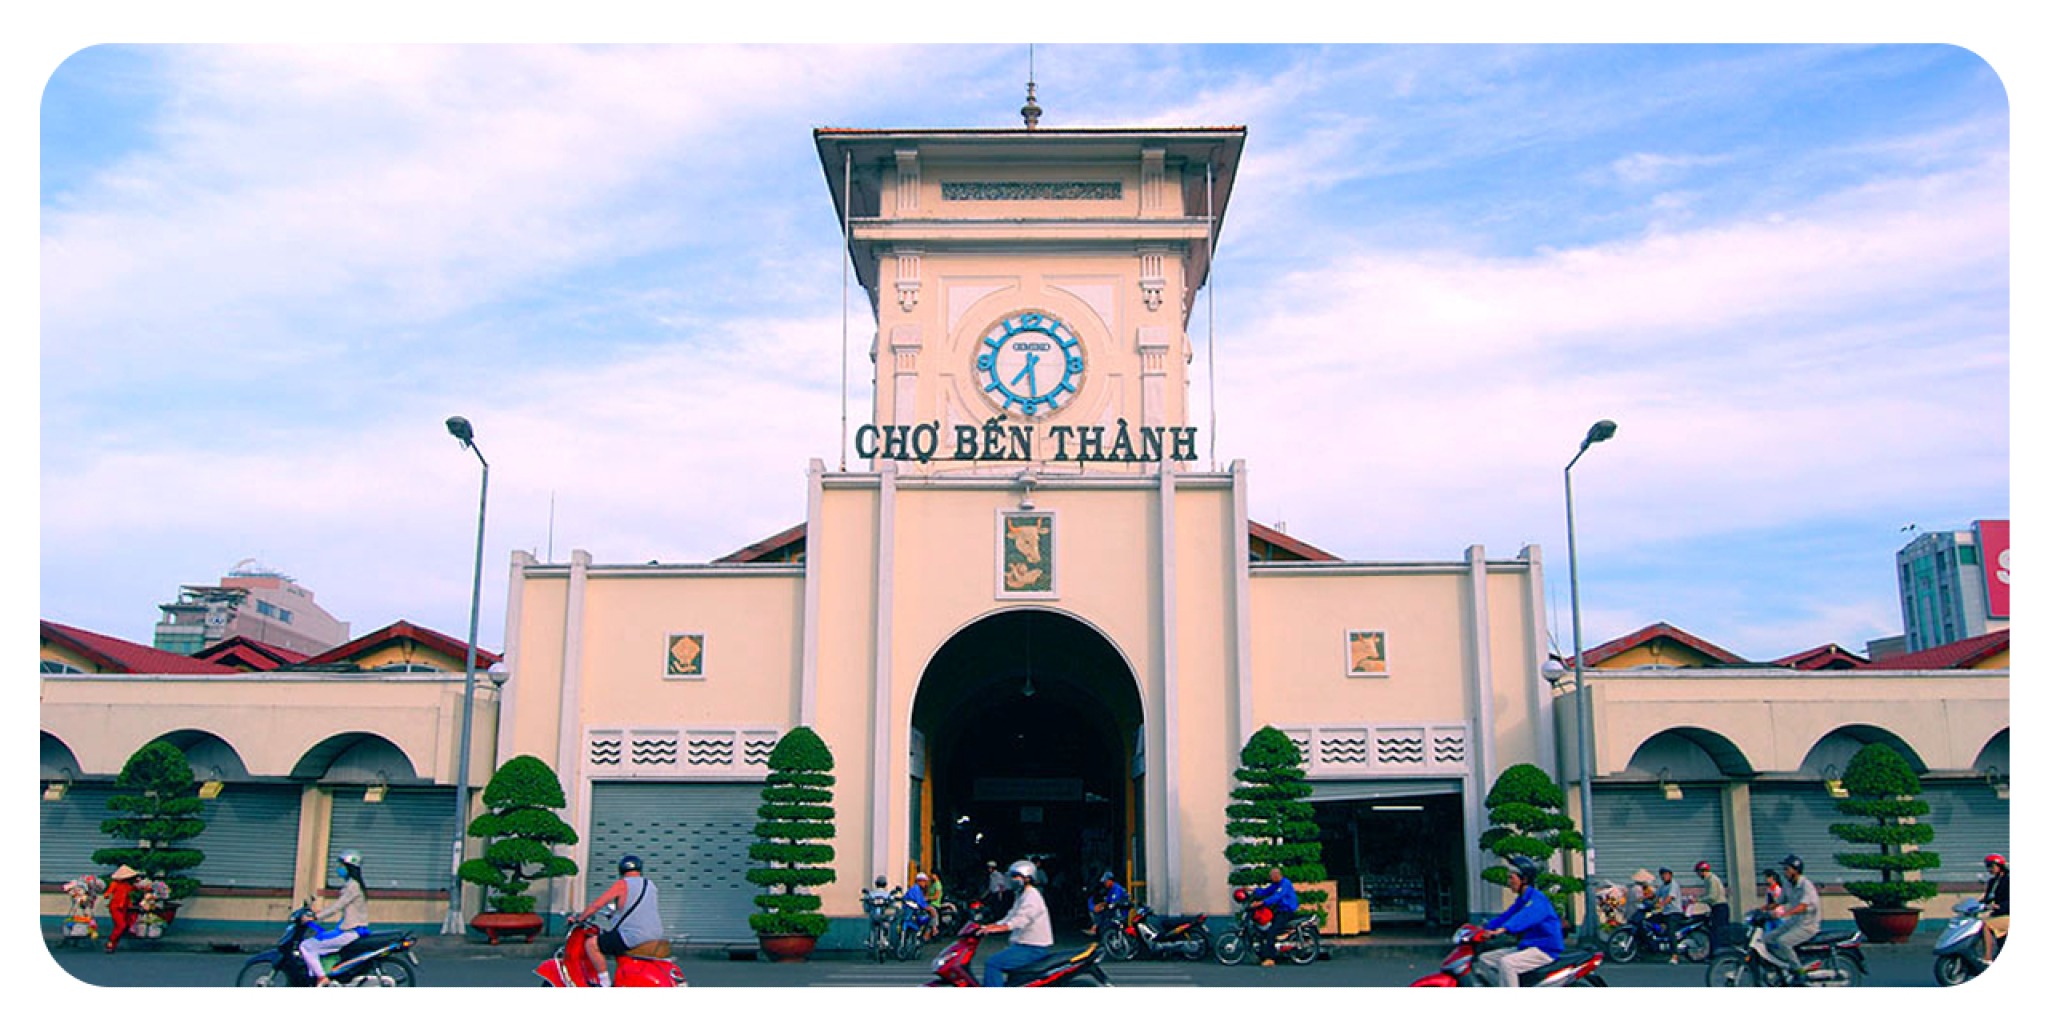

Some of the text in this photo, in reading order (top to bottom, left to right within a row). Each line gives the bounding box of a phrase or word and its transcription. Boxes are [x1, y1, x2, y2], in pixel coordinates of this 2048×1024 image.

[1020, 313, 1043, 329] 12
[855, 414, 1197, 464] CHỢ BẾN THÀNH
